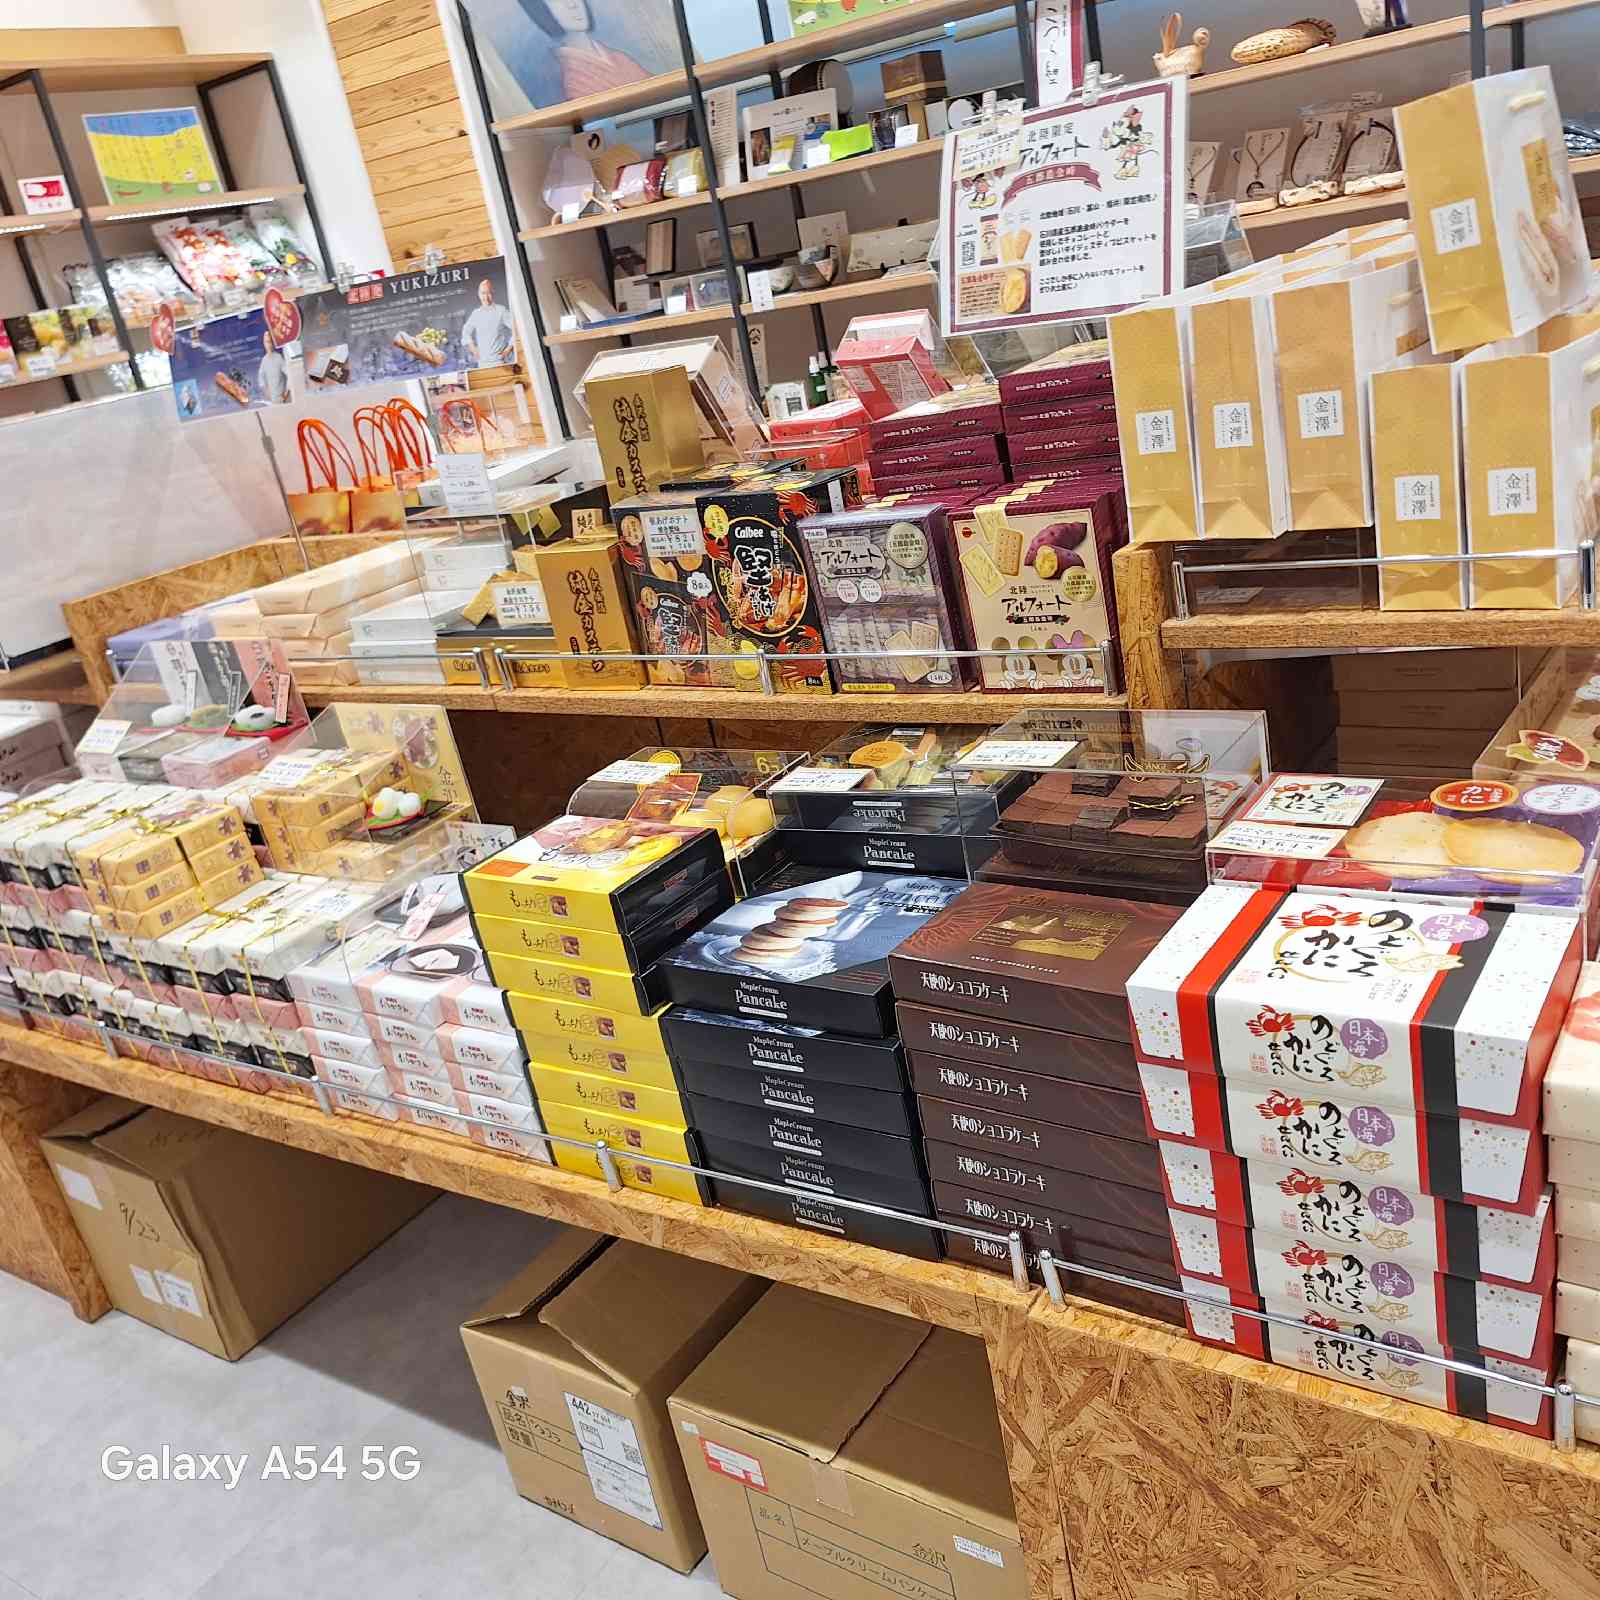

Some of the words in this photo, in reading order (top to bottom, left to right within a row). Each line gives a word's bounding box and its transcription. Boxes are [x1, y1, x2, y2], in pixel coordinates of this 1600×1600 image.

[390, 266, 471, 295] YUKIZURI
[734, 526, 764, 539] Calbee
[821, 548, 882, 565] アルフォート
[1001, 594, 1073, 615] アルフォート
[863, 845, 915, 861] Pancake
[1424, 913, 1472, 940] 日本海
[1304, 929, 1355, 968] かに
[735, 989, 788, 1011] Pancake
[740, 981, 780, 996] MapleCream
[920, 971, 1009, 1004] 天使のショコラケーキ
[752, 1036, 794, 1050] MapleCream
[928, 1021, 1020, 1054] 天使のショコラケーキ
[1283, 1033, 1313, 1073] かに
[1310, 1014, 1341, 1083] のどぐろ
[1348, 1019, 1380, 1057] 日本海
[748, 1043, 804, 1065] Pancake
[760, 1082, 815, 1106] Pancake
[764, 1075, 805, 1090] MapleCream
[938, 1067, 1029, 1102] 天使のショコラケーキ
[768, 1124, 823, 1149] Pancake
[774, 1117, 814, 1133] MapleCream
[951, 1113, 1041, 1149] 天使のショコラケーキ
[1293, 1117, 1322, 1157] かに
[1318, 1101, 1349, 1166] のどぐろ
[1356, 1108, 1388, 1145] 日本海
[780, 1161, 835, 1187] Pancake
[785, 1155, 825, 1172] MapleCream
[956, 1155, 1047, 1192] 天使のショコラケーキ
[792, 1203, 844, 1226] Pancake
[964, 1198, 1054, 1235] 天使のショコラケーキ
[1313, 1194, 1342, 1233] かに
[1338, 1180, 1369, 1243] のどぐろ
[1375, 1187, 1407, 1223] 日本海
[1315, 1266, 1345, 1304] かに
[1340, 1254, 1371, 1315] のどぐろ
[1377, 1263, 1408, 1294] 日本海
